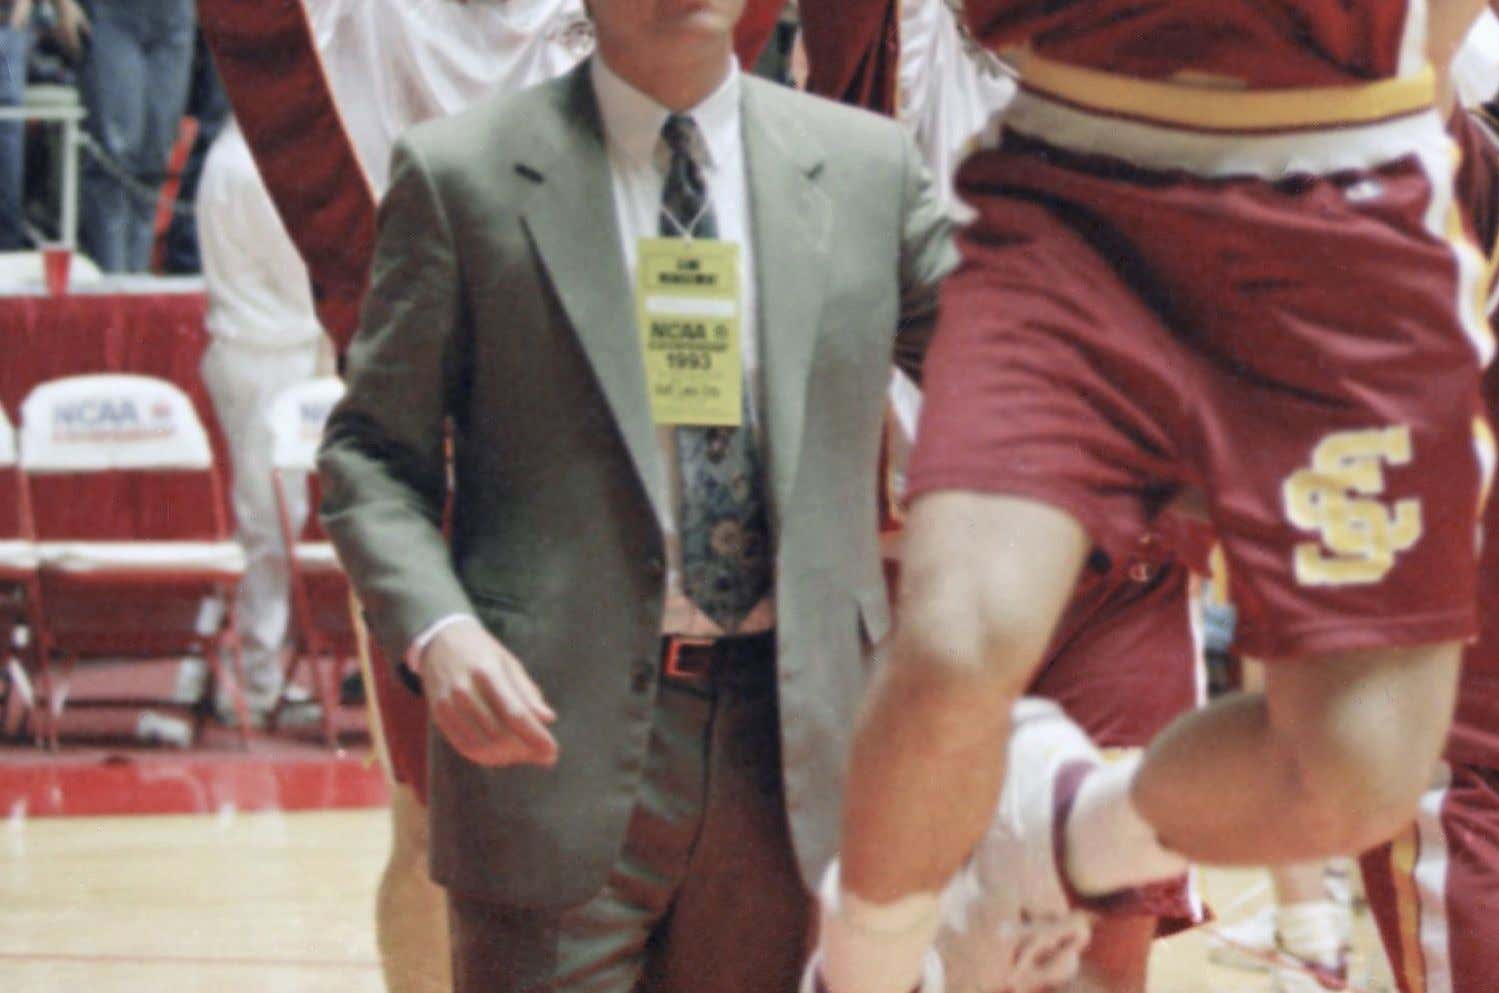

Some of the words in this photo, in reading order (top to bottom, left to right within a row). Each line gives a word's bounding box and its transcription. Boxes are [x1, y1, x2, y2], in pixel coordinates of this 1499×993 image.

[651, 322, 705, 339] NCAA
[667, 353, 712, 369] 1993
[52, 399, 138, 426] NCAA
